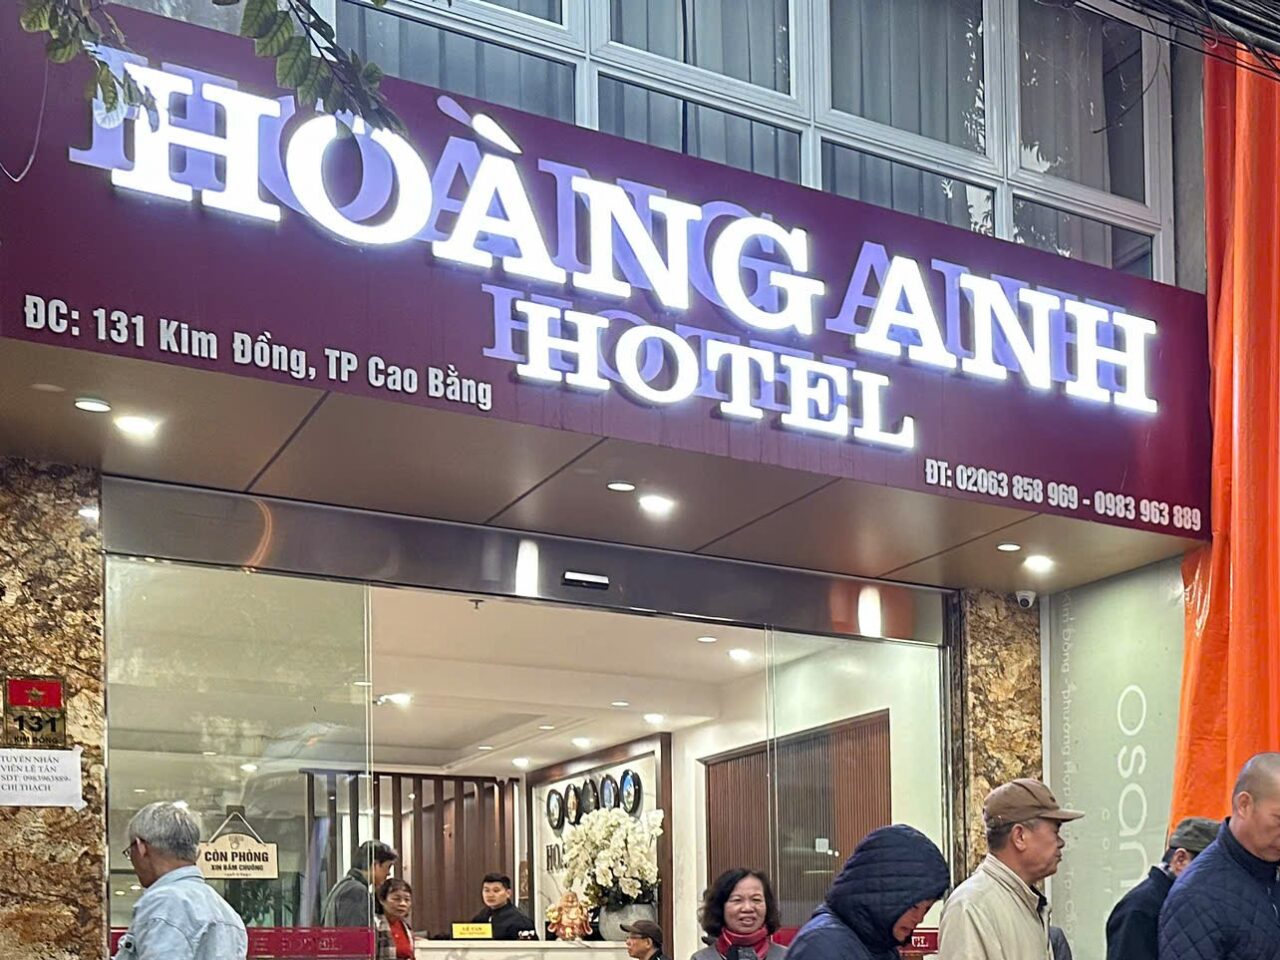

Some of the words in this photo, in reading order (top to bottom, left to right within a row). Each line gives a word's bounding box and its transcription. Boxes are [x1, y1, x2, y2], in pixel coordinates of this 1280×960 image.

[108, 60, 825, 336] HOÀNG
[855, 254, 1158, 414] ANH
[24, 294, 80, 337] ĐC:
[93, 308, 145, 347] 131
[159, 318, 218, 360] Kim
[232, 331, 317, 380] Đồng,
[324, 348, 358, 382] TP
[368, 356, 418, 394] Cao
[428, 364, 493, 412] Bằng
[515, 298, 915, 450] HOTEL
[925, 458, 952, 488] ĐT:
[956, 464, 1009, 498] 02063
[1012, 474, 1044, 504] 858
[1047, 482, 1079, 510] 969
[1094, 490, 1136, 521] 0983
[1140, 499, 1170, 526] 963
[1173, 505, 1202, 532] 889
[13, 715, 57, 732] 131
[204, 848, 228, 862] CÒN
[231, 848, 269, 862] PHÒNG
